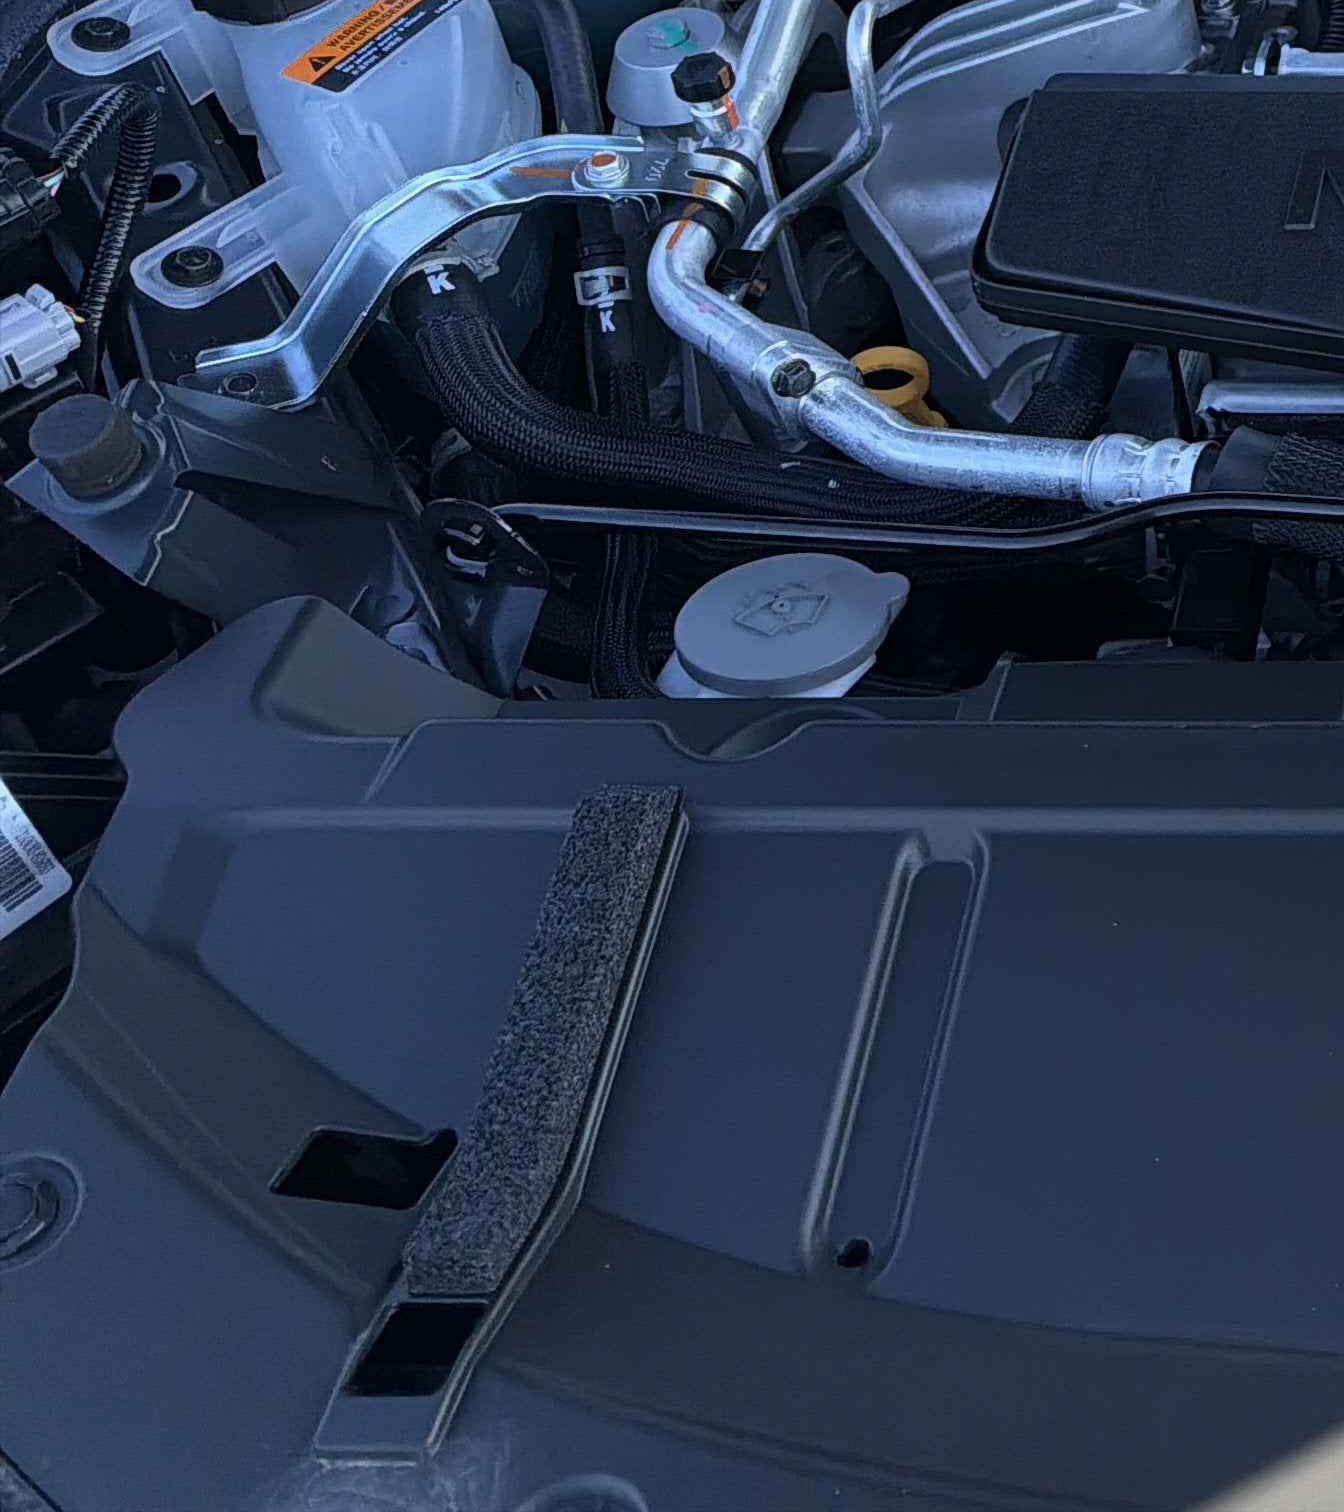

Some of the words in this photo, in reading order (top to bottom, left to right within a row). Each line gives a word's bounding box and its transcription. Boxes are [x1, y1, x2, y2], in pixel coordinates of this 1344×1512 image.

[326, 10, 379, 49] WARNING
[427, 271, 456, 295] K
[599, 309, 617, 333] K
